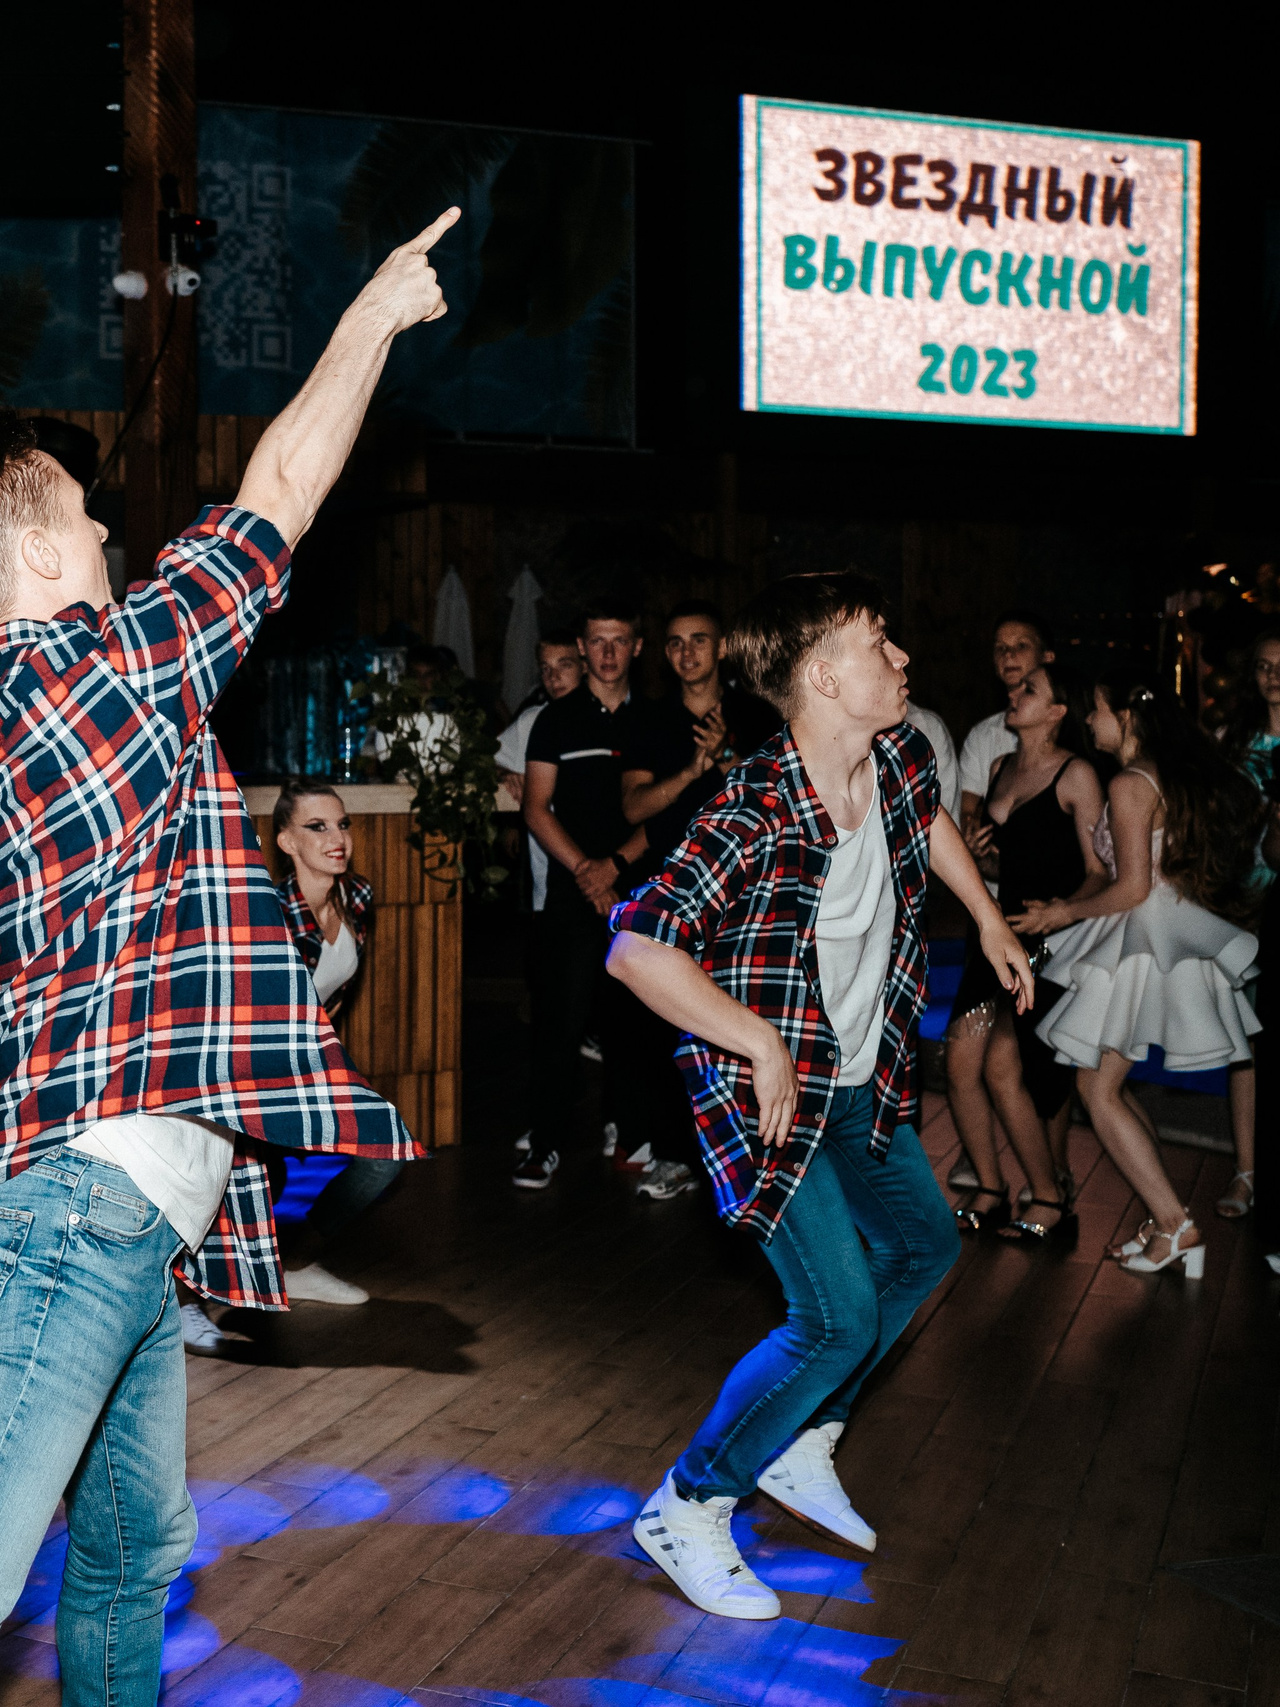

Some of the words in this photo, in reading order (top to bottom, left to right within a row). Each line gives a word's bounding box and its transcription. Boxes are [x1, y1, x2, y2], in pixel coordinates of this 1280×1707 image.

[813, 148, 1136, 230] ЗВЕЗДНЫЙ
[783, 233, 1151, 317] ВЫПУСКНОЙ
[917, 342, 1038, 400] 2023
